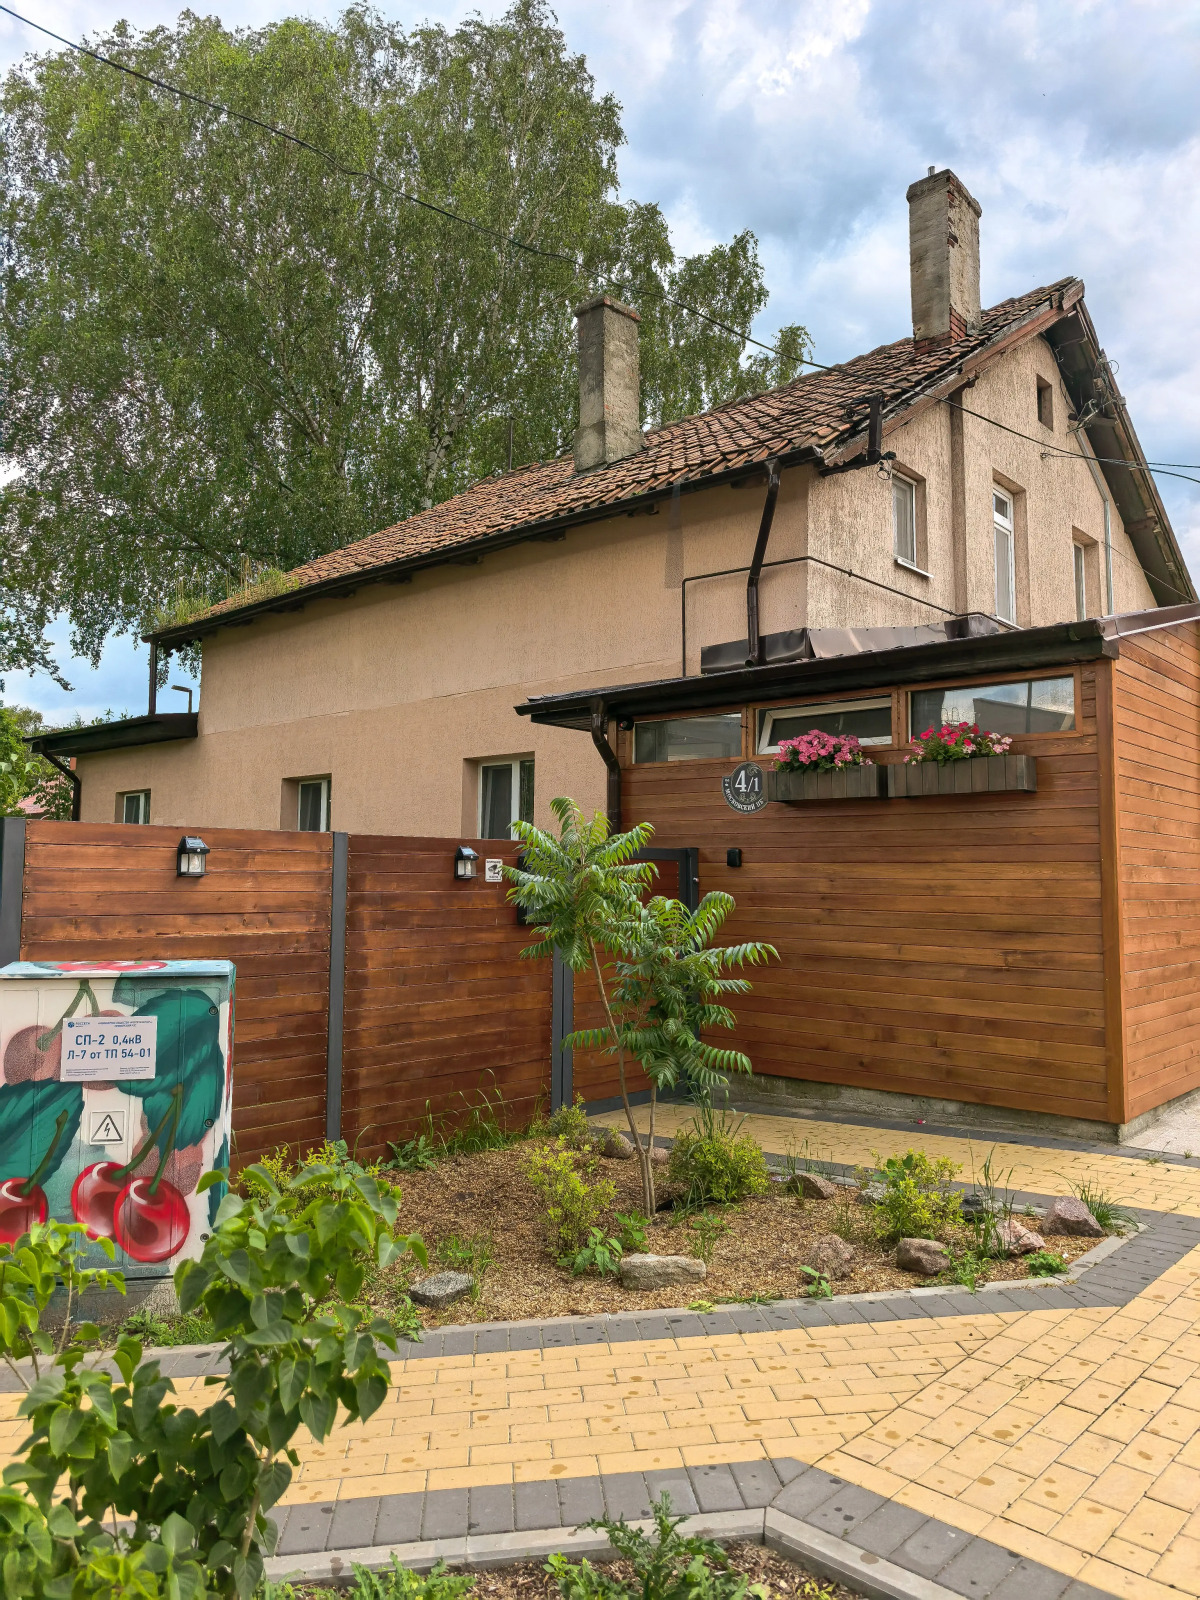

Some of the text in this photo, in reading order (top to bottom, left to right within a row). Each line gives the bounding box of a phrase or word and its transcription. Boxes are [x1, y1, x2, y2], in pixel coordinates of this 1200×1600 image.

[735, 770, 759, 792] 4/1
[75, 1034, 142, 1046] СП-2 0,4кВ
[67, 1047, 151, 1060] Л-7 от ТП 54-01
